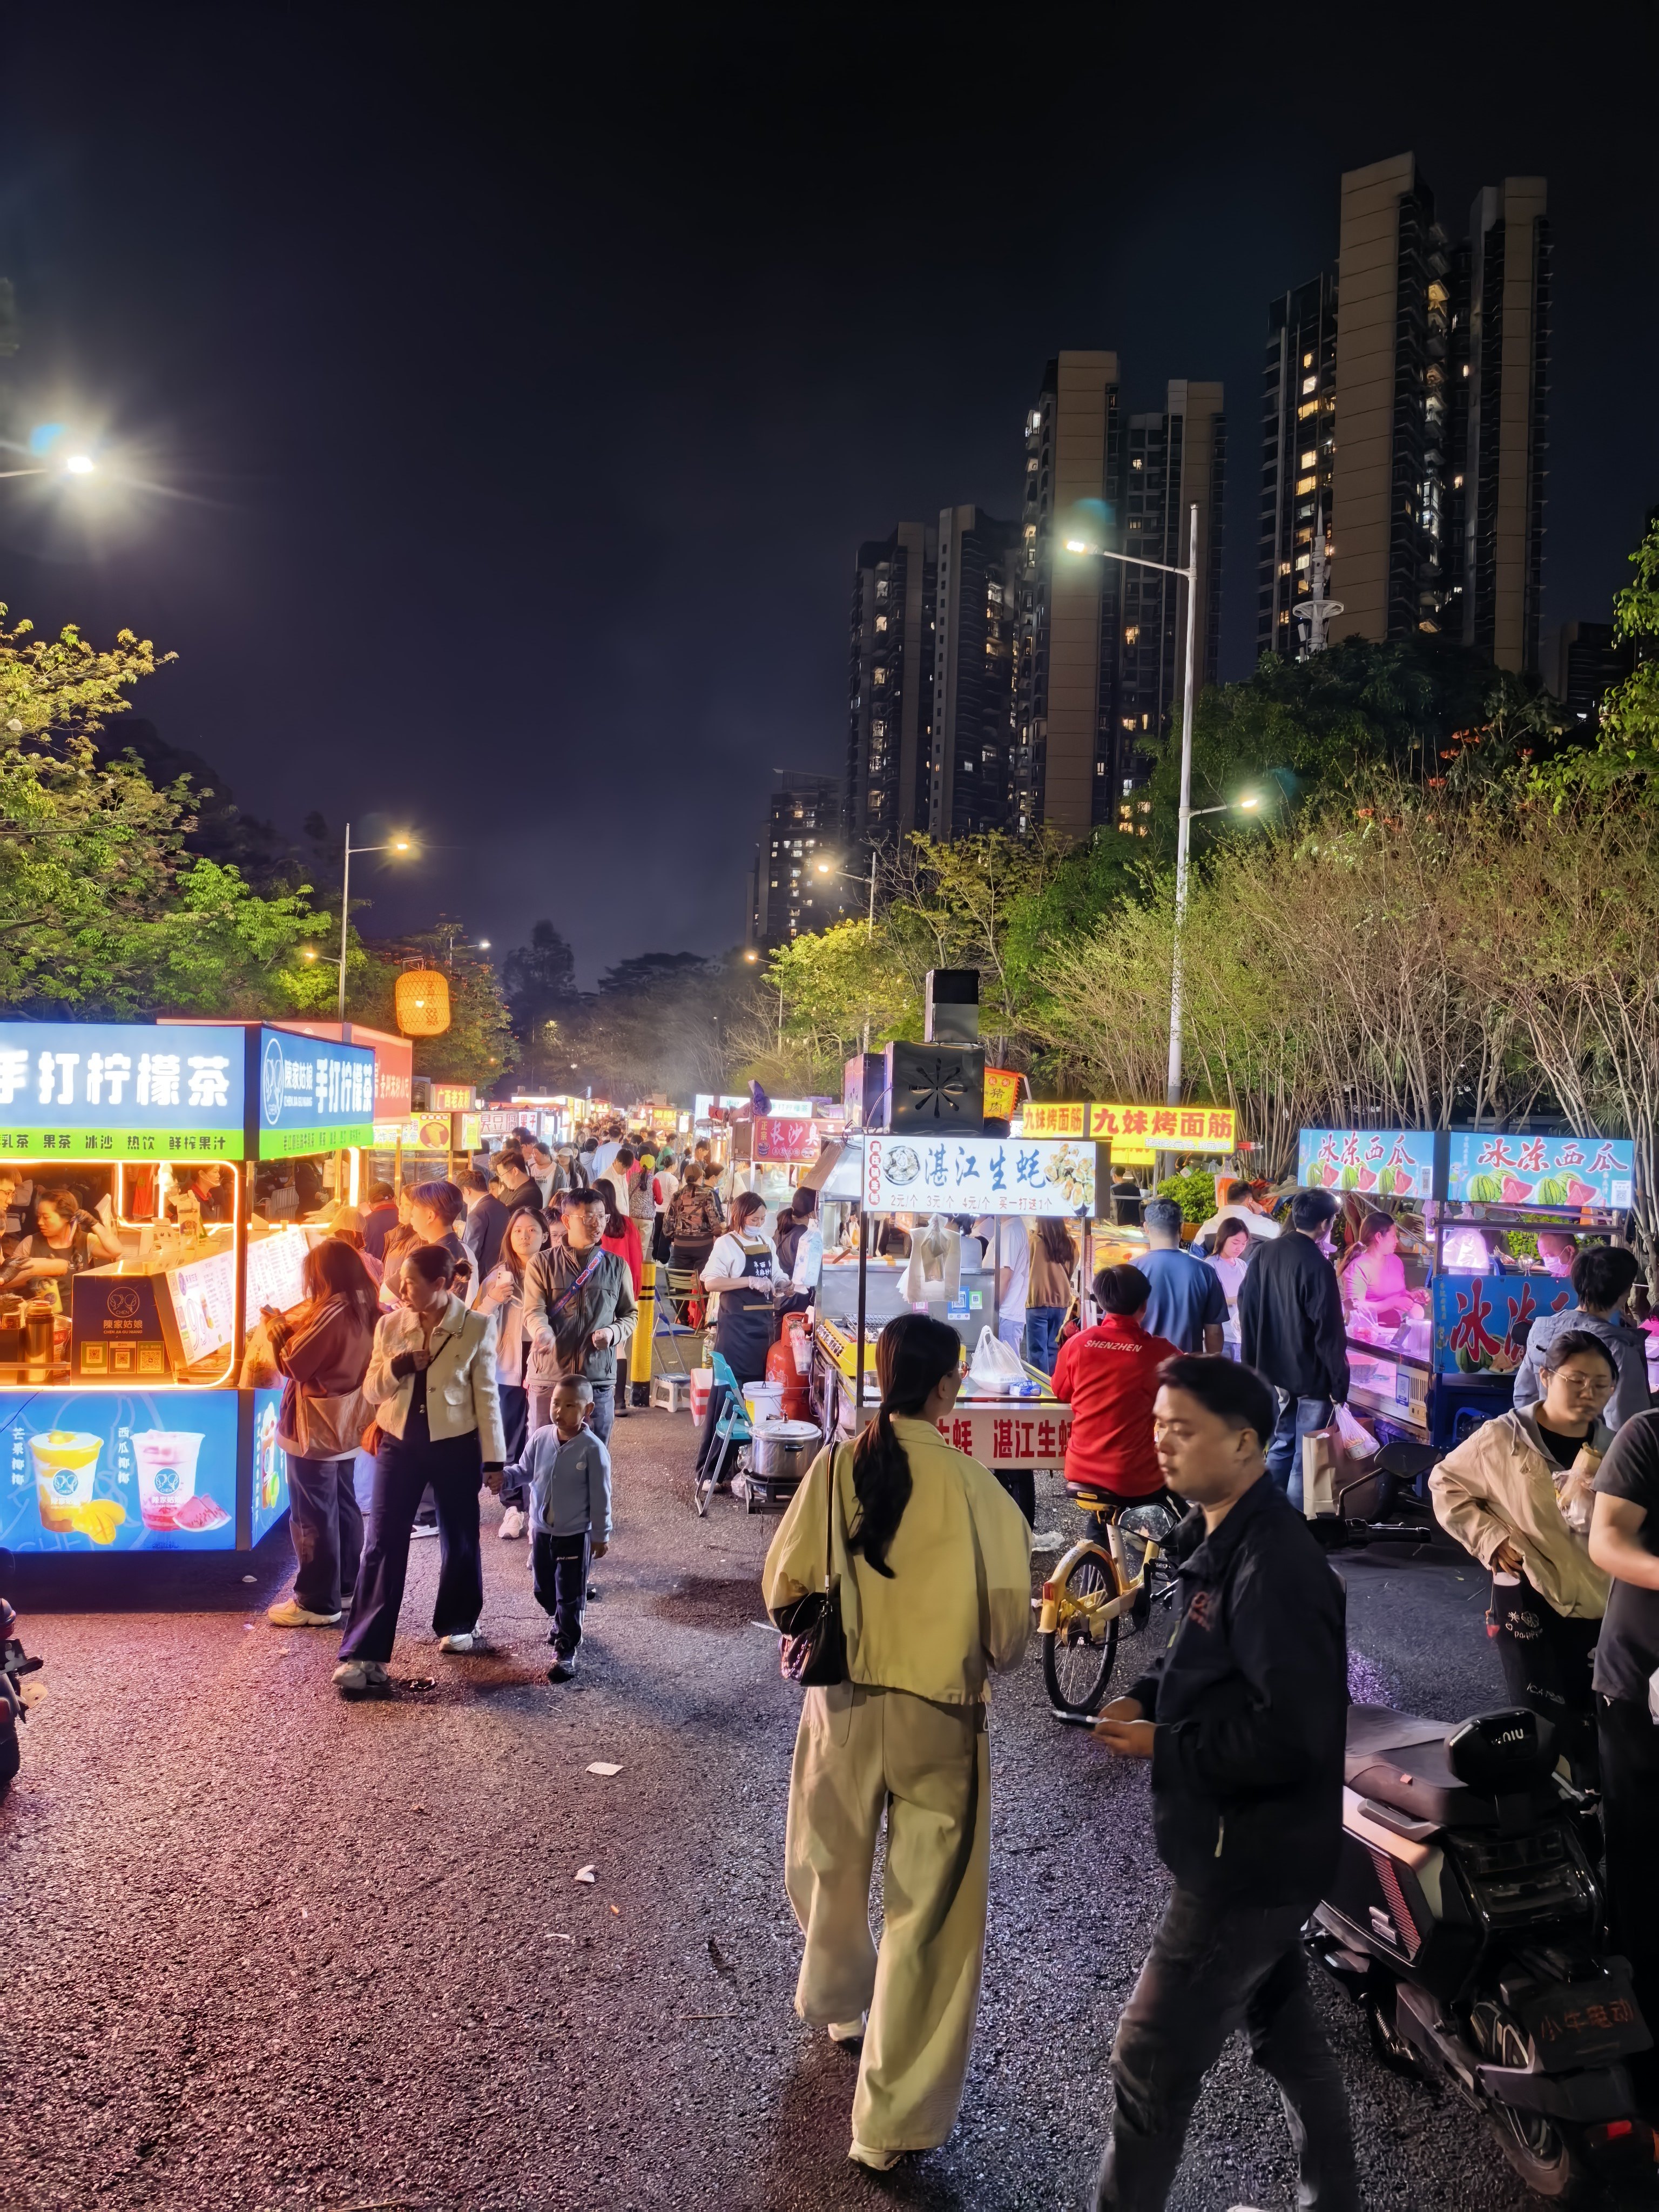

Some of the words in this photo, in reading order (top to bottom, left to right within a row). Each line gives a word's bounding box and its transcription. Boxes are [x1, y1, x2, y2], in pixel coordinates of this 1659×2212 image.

[0, 1050, 230, 1106] 手打柠檬茶
[316, 1058, 373, 1114] 手打柠檬茶
[437, 1088, 470, 1110] 广西老友粉
[988, 1088, 1005, 1114] 猪肉
[760, 1121, 768, 1141] 正宗
[1024, 1107, 1082, 1132] 九妹烤面筋
[1093, 1108, 1233, 1138] 九妹烤面筋
[44, 1135, 71, 1149] 果茶
[85, 1135, 113, 1149] 冰沙
[127, 1136, 155, 1150] 热饮
[169, 1136, 226, 1150] 鲜榨果汁
[770, 1120, 820, 1147] 长沙臭
[1318, 1130, 1416, 1166] 冰冻西瓜
[1478, 1137, 1629, 1172] 冰冻西瓜
[925, 1143, 1047, 1191] 湛江生蚝
[891, 1194, 918, 1208] 2元/个
[962, 1196, 990, 1210] 4元/个
[103, 1320, 143, 1328] 陳家姑娘
[1084, 1340, 1142, 1352] SHENZHEN
